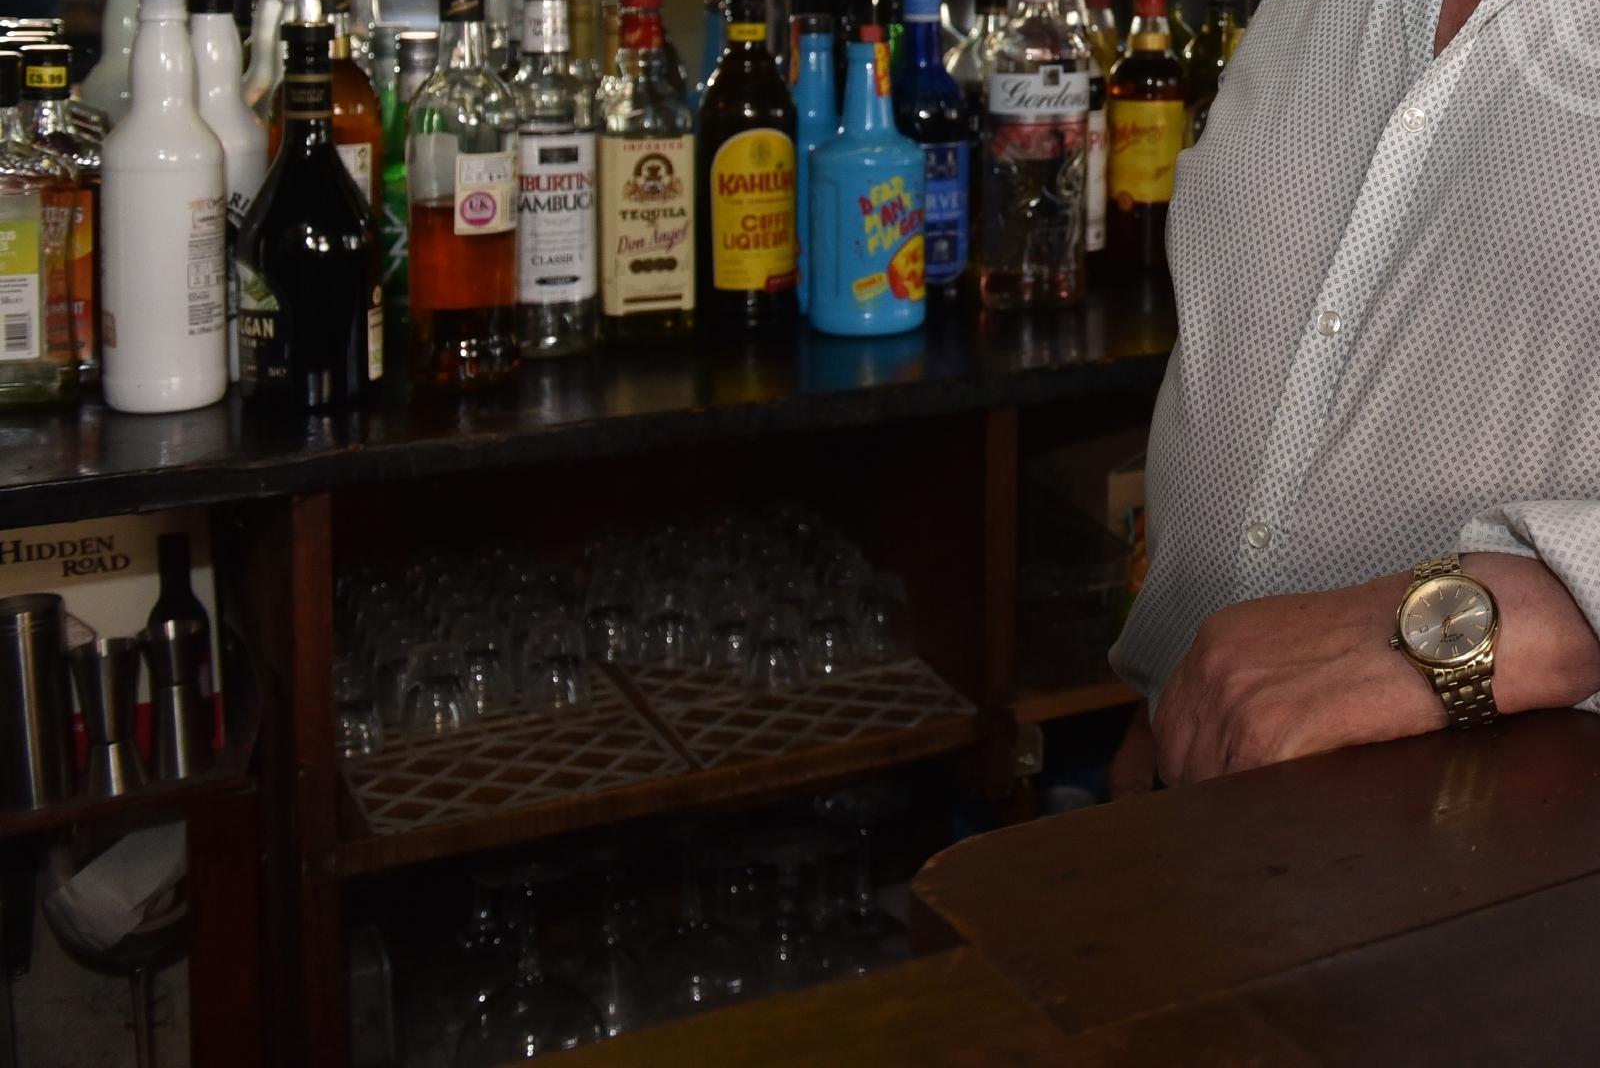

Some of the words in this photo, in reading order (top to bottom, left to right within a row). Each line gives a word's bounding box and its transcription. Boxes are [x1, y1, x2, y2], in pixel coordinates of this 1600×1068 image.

[619, 207, 688, 228] TEQUILA
[616, 235, 646, 255] Don
[0, 535, 115, 565] HIDDEN
[61, 554, 131, 578] ROAD
